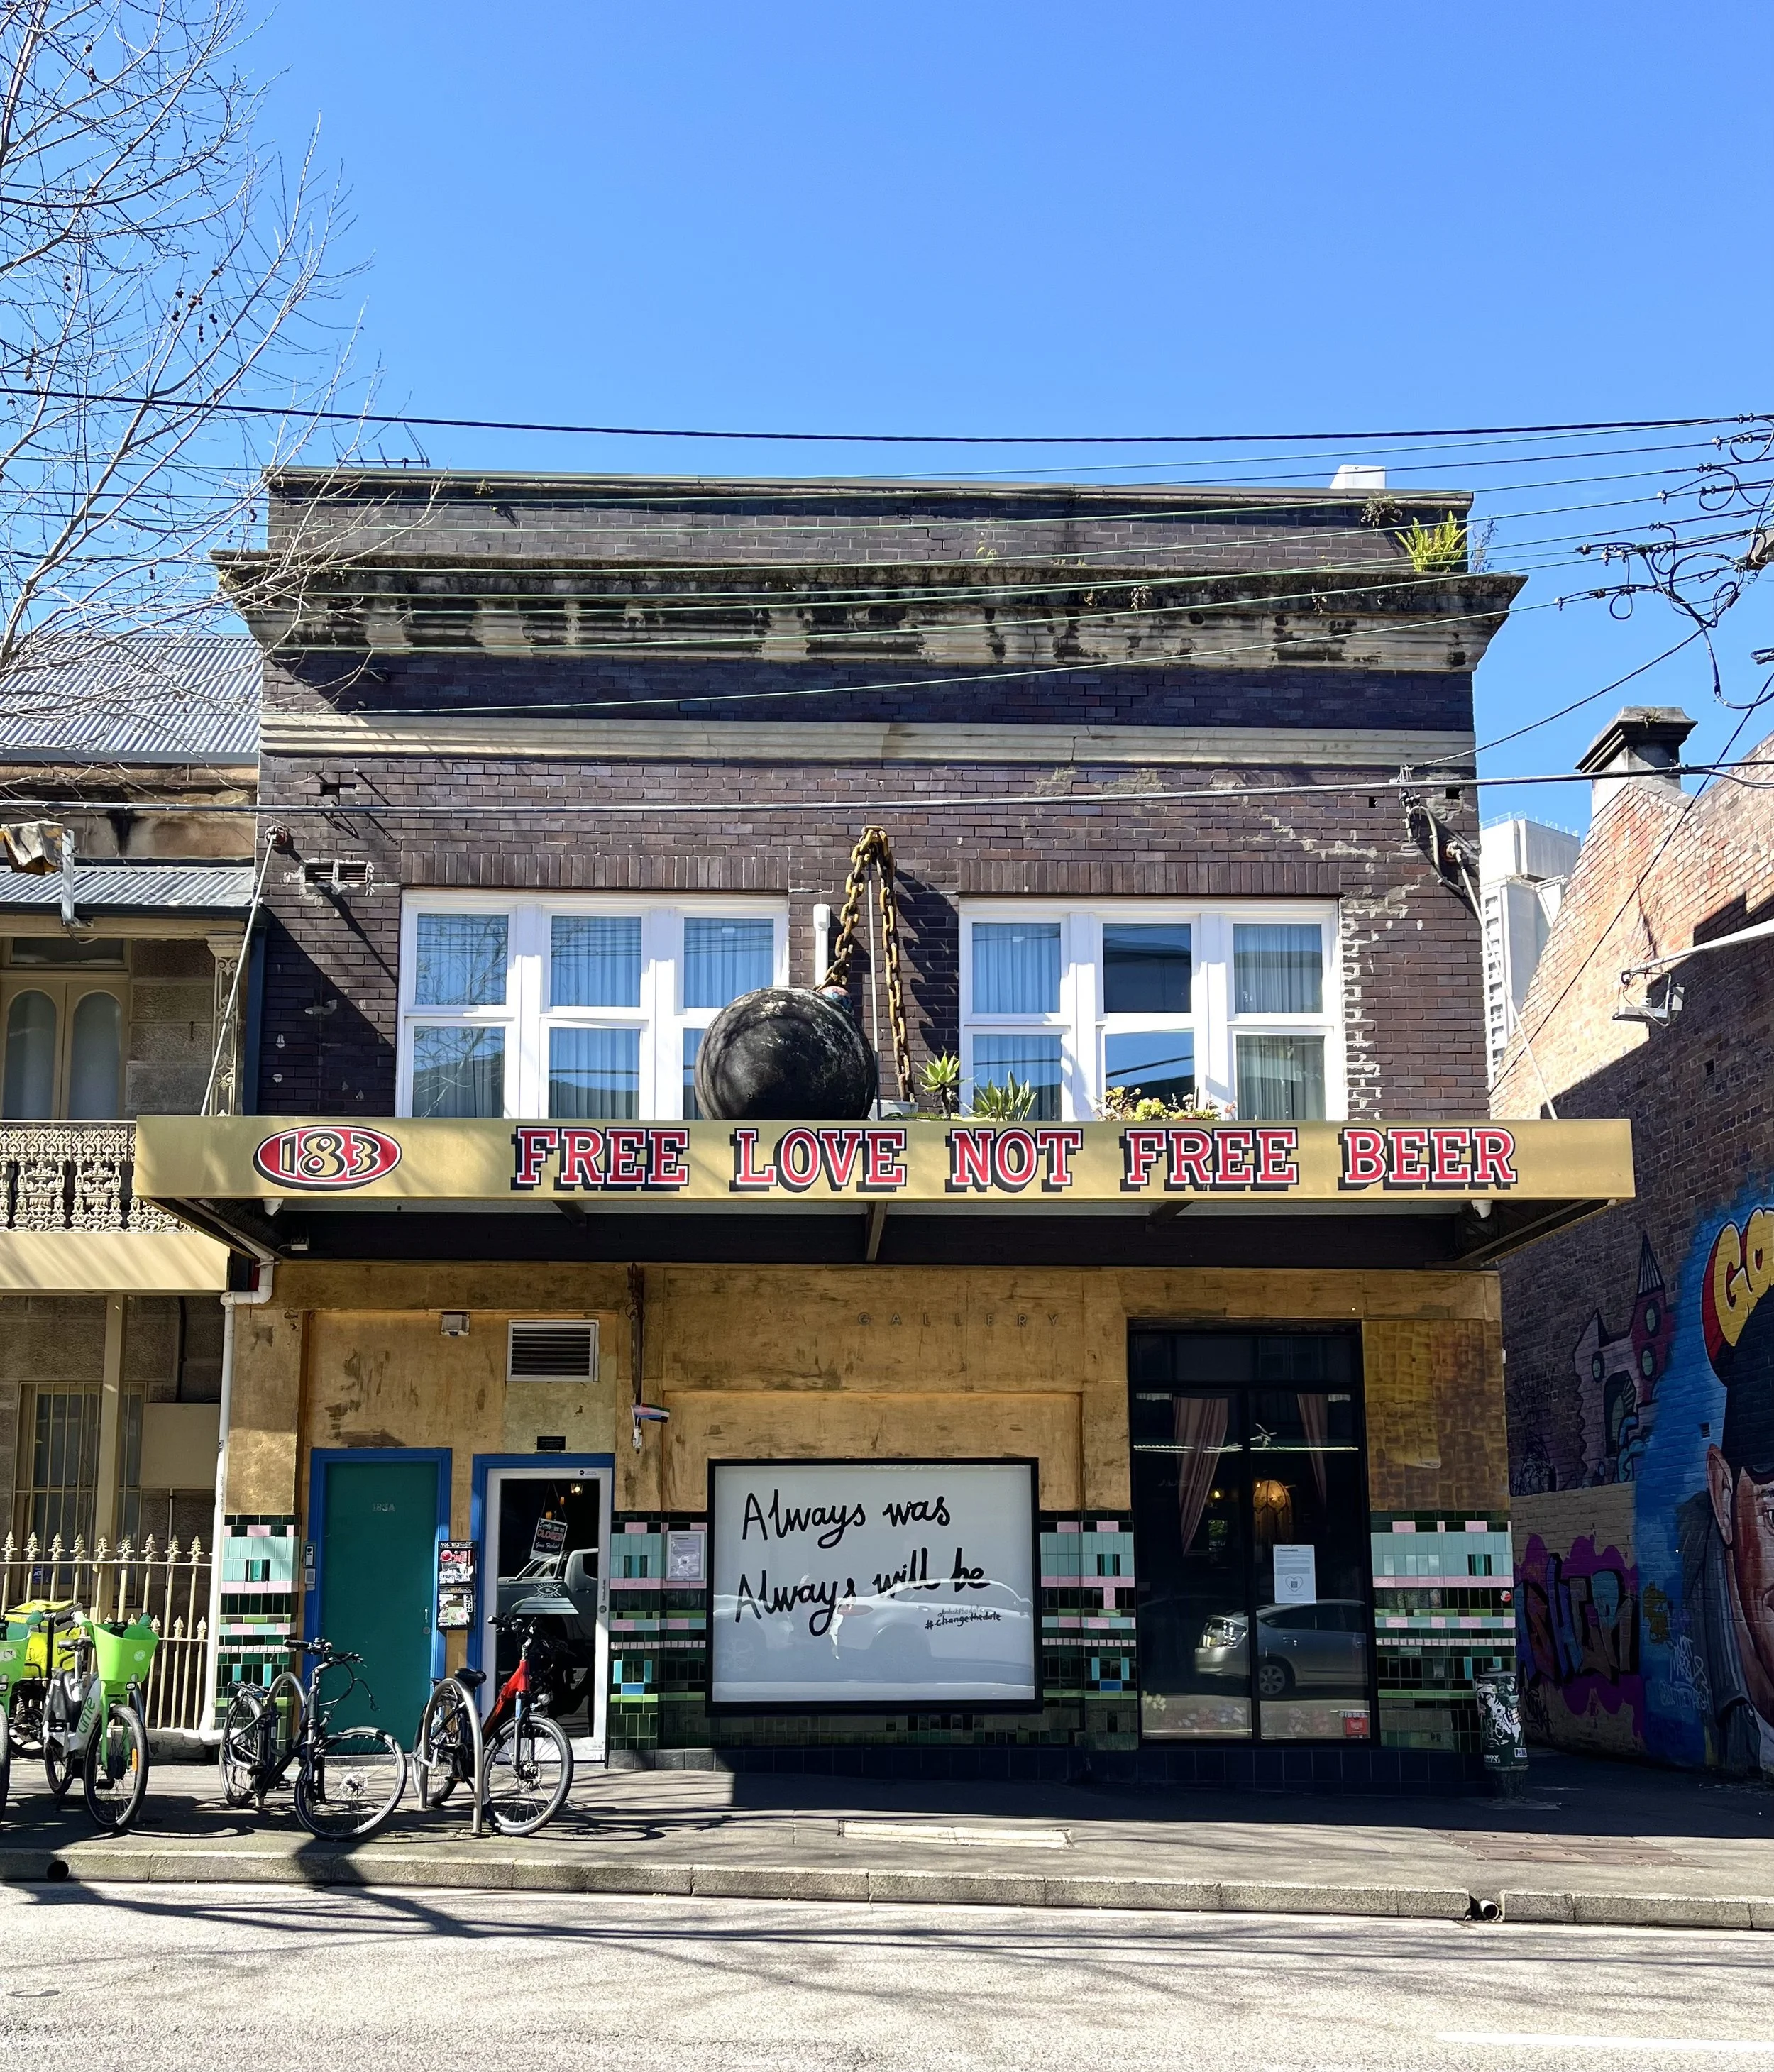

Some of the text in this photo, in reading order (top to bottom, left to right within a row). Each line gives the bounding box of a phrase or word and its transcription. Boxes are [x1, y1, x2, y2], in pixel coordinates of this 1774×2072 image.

[279, 1131, 382, 1181] 183
[510, 1127, 1516, 1192] FREE LOVE NOT FREE BEER
[856, 1311, 1060, 1327] GALLERY
[742, 1489, 951, 1549] Always was
[734, 1547, 991, 1636] Always will be
[925, 1611, 1002, 1631] #changethedate
